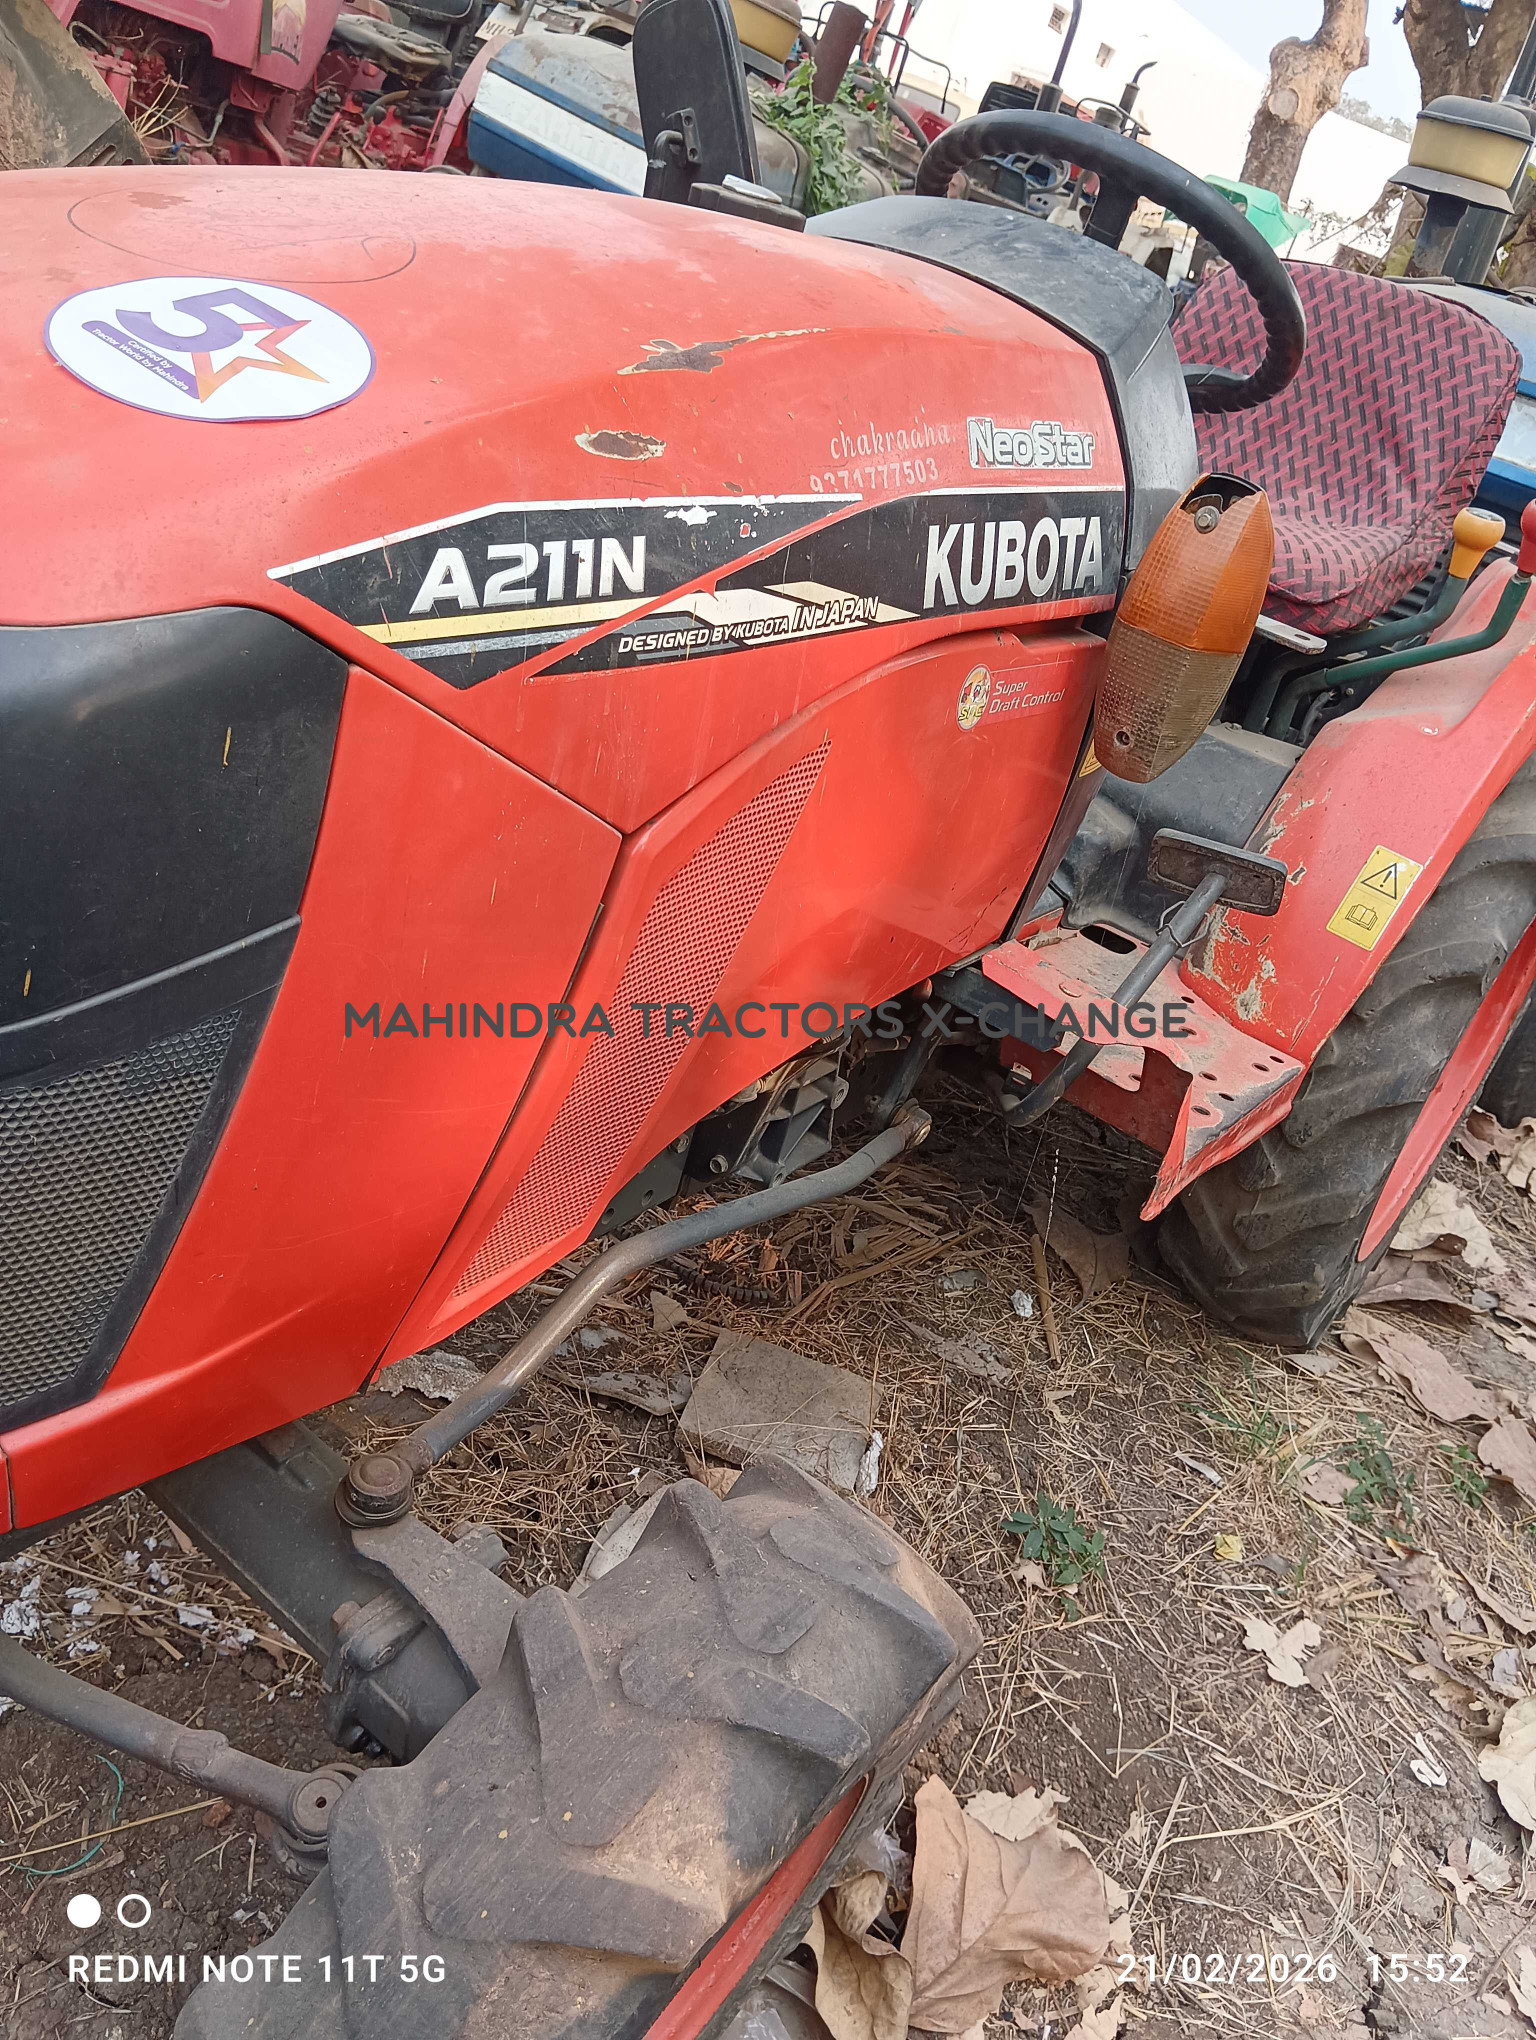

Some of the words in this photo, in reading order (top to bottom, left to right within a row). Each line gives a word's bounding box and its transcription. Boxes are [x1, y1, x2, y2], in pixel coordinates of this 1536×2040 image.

[92, 328, 120, 346] Tractor
[118, 343, 145, 361] World
[141, 358, 155, 368] by
[152, 365, 189, 391] Mahindra
[127, 340, 164, 362] Certified
[159, 358, 173, 369] by
[968, 417, 1095, 468] NeoStar
[409, 535, 647, 615] A211N
[923, 516, 1103, 610] KUBOTA
[617, 630, 709, 653] DESIGNED
[711, 625, 732, 643] BY
[735, 616, 790, 639] KUBOTA
[791, 605, 816, 632] IN
[815, 596, 879, 627] JAPAN
[988, 697, 1020, 714] Draft
[1021, 688, 1066, 708] Control
[992, 681, 1029, 696] Super
